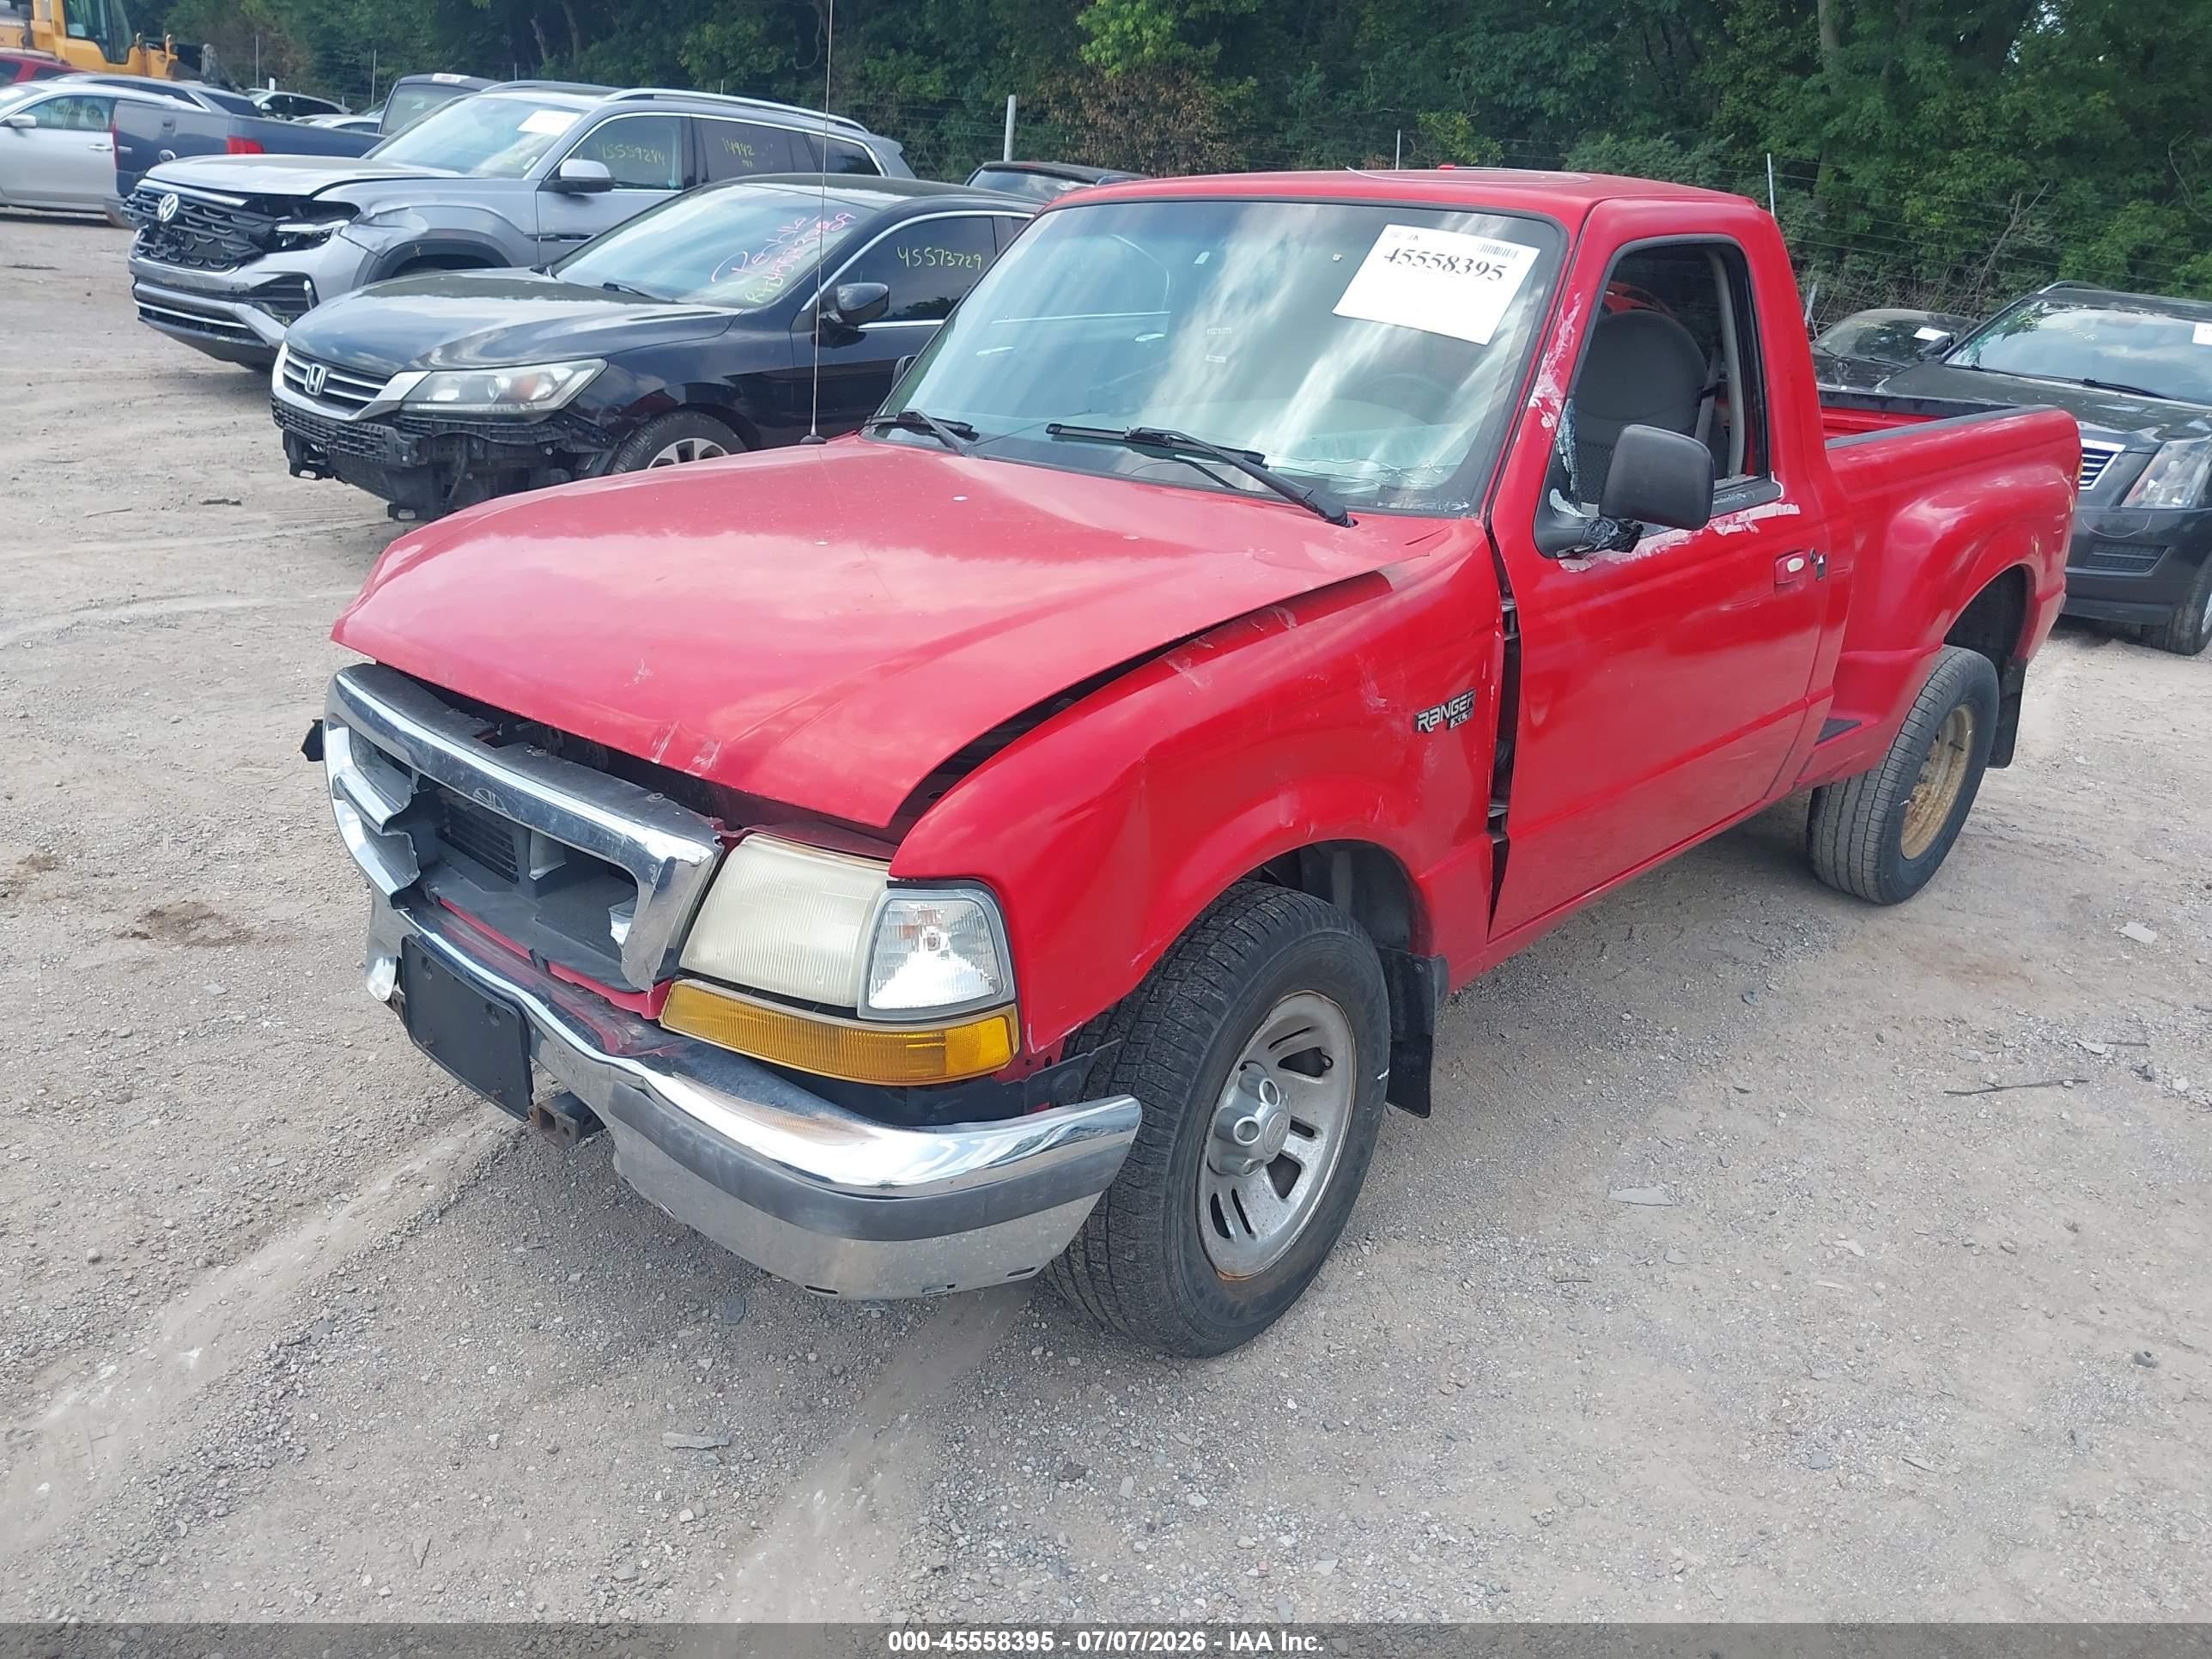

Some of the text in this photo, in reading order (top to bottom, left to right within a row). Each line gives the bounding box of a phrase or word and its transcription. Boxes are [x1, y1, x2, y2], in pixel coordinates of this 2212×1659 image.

[896, 246, 982, 270] 45573729
[1383, 246, 1508, 282] 45558395
[1414, 687, 1477, 733] RANGER
